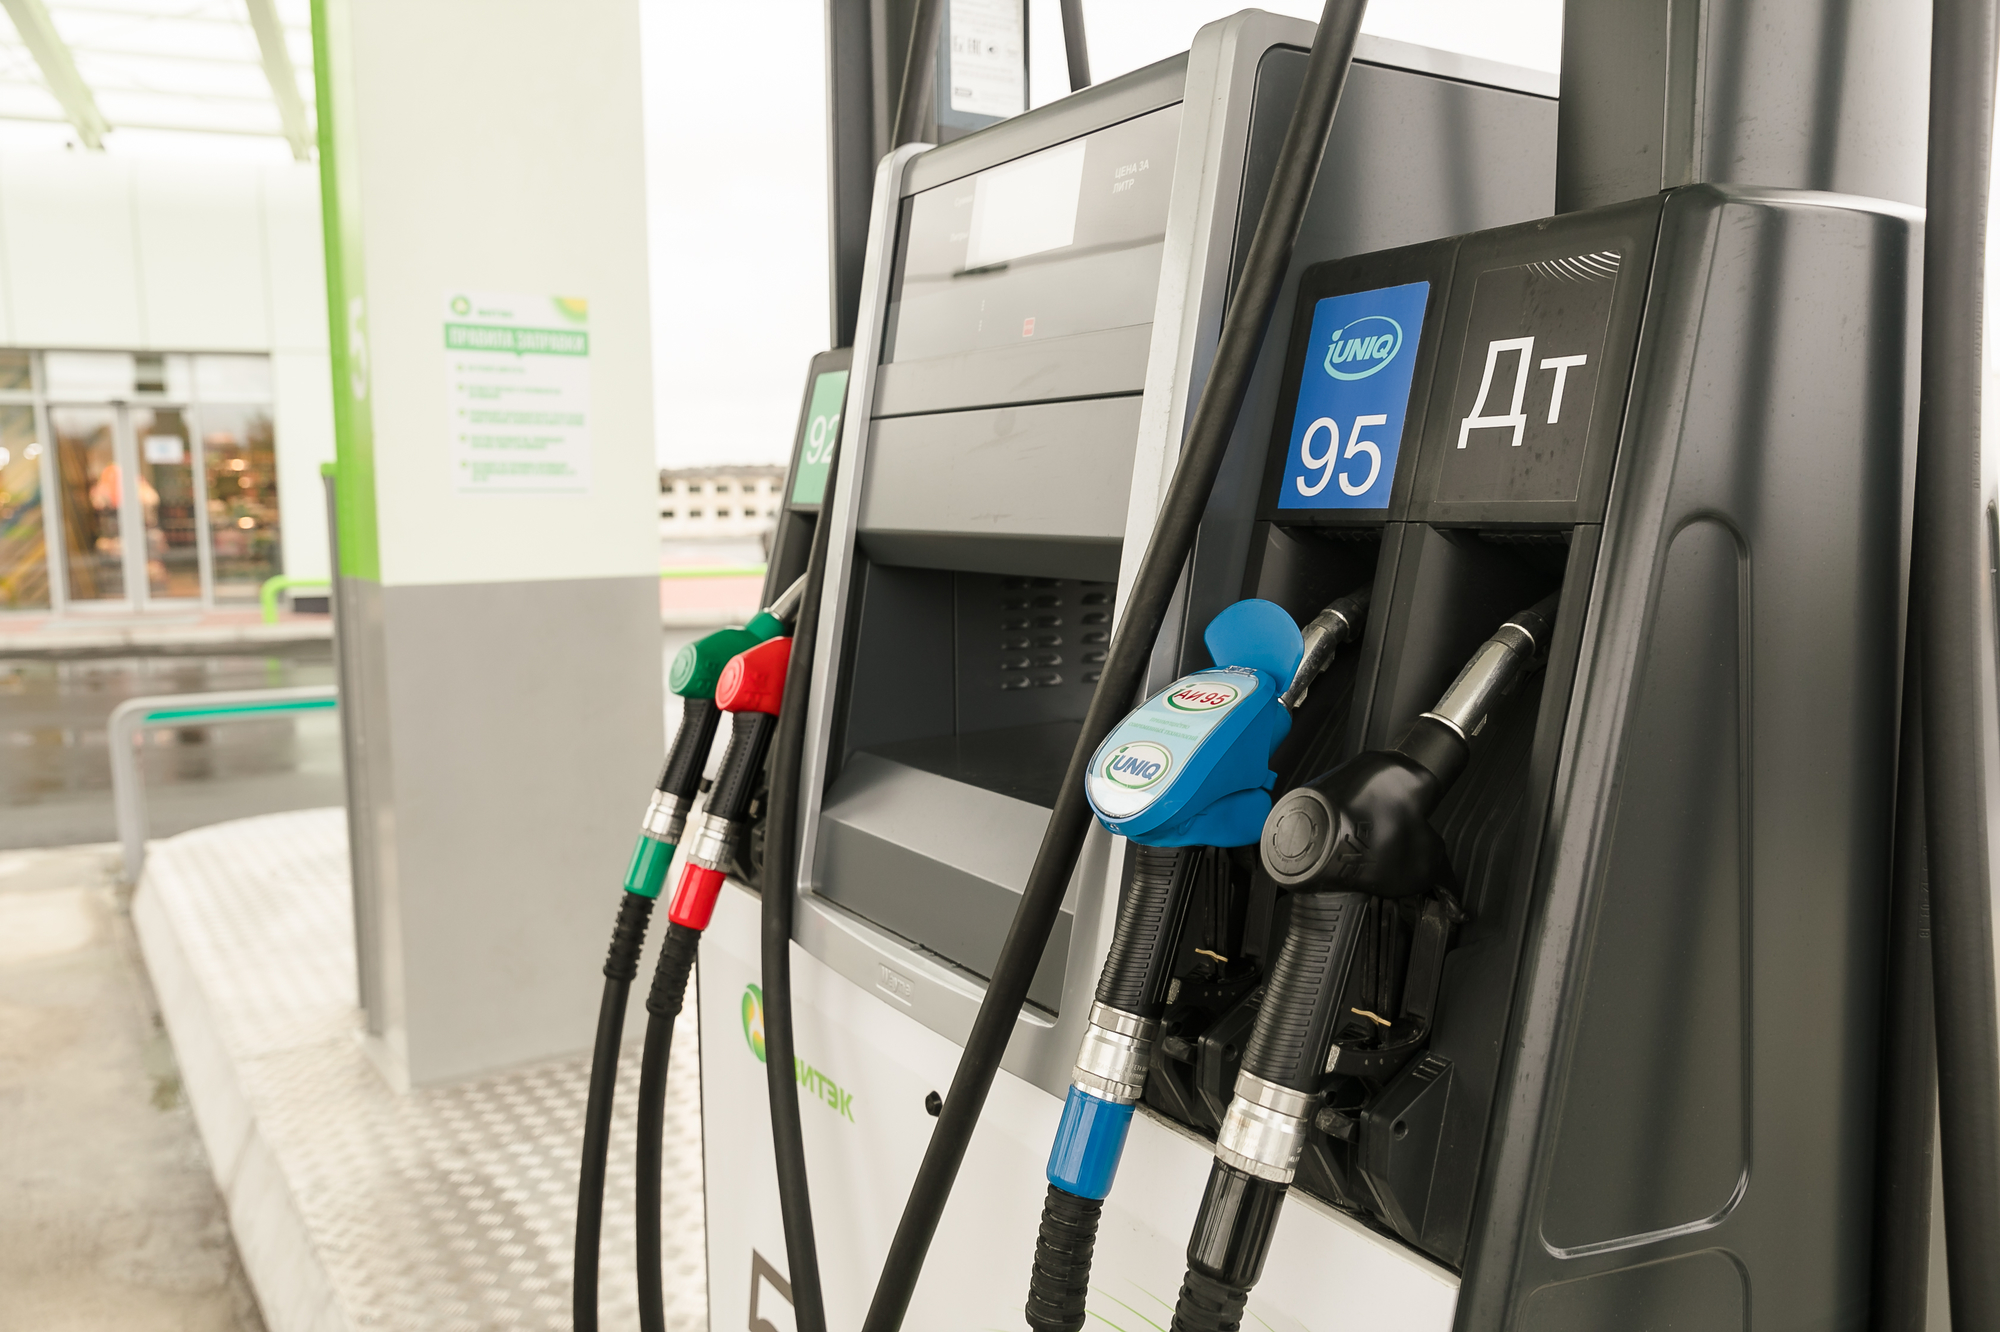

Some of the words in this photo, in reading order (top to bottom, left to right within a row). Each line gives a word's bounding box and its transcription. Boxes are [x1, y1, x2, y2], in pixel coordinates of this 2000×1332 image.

[1114, 162, 1137, 179] ЦЕНА
[1138, 159, 1149, 171] ЗА
[1112, 178, 1135, 194] ЛИТР
[806, 413, 840, 465] 92
[1296, 414, 1388, 497] 95
[1200, 692, 1231, 706] 95
